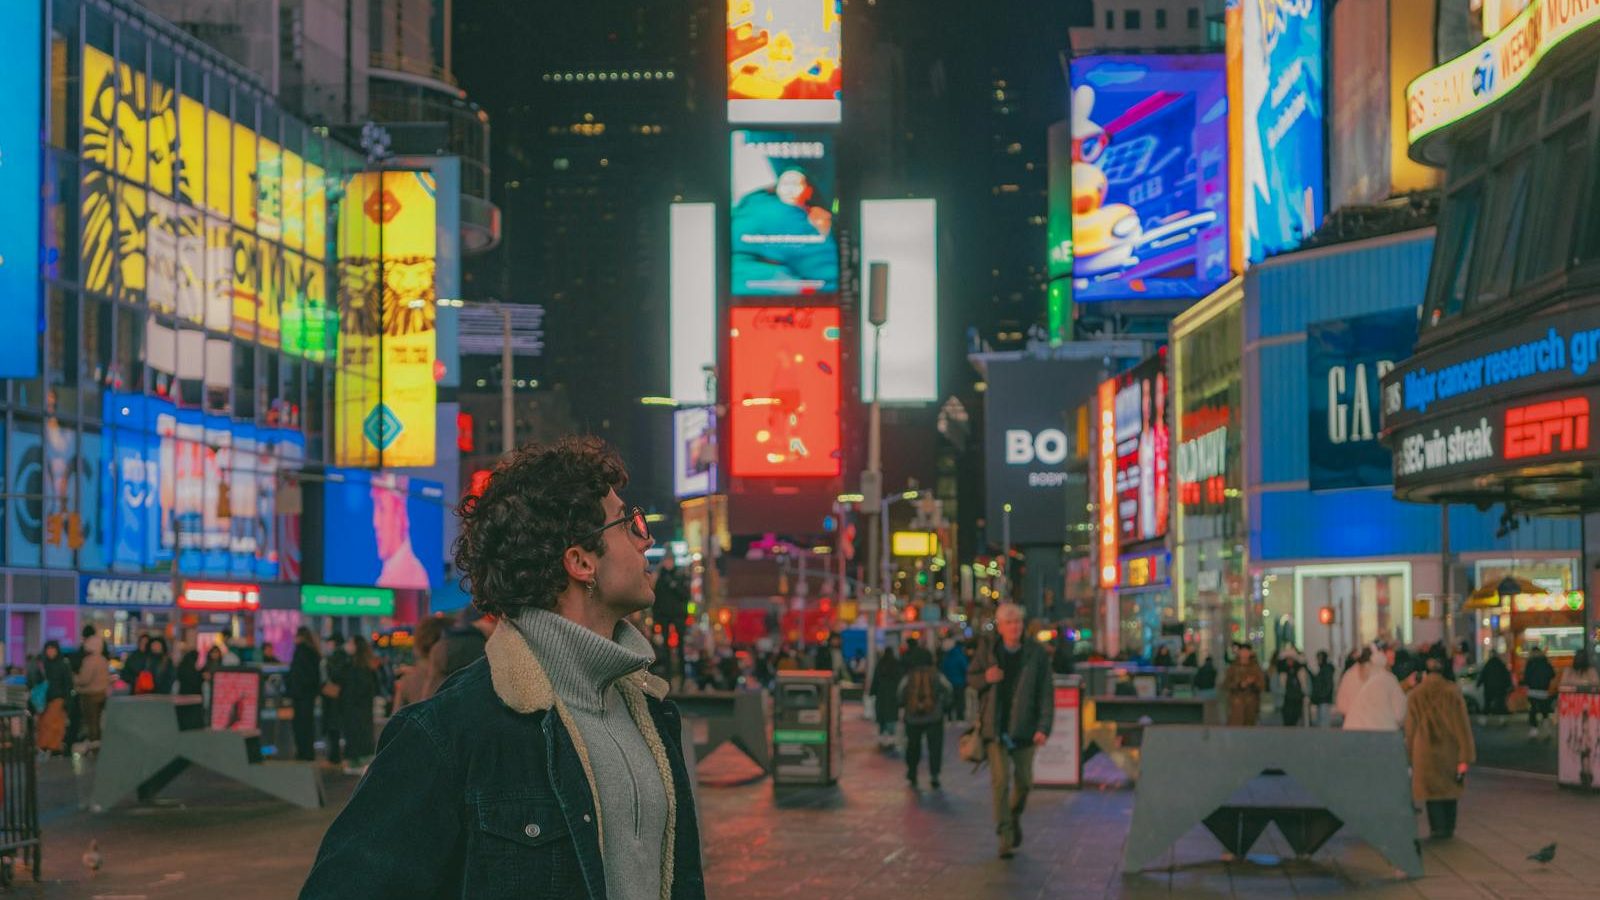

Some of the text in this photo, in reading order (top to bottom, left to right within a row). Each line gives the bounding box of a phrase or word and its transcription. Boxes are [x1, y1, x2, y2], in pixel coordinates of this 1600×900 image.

[1404, 367, 1436, 414] Major
[1437, 357, 1484, 400] cancer
[1485, 327, 1566, 386] research
[1425, 429, 1447, 469] win
[1448, 417, 1493, 464] streak
[1504, 397, 1589, 460] ESPN
[86, 578, 174, 606] SKECHERS
